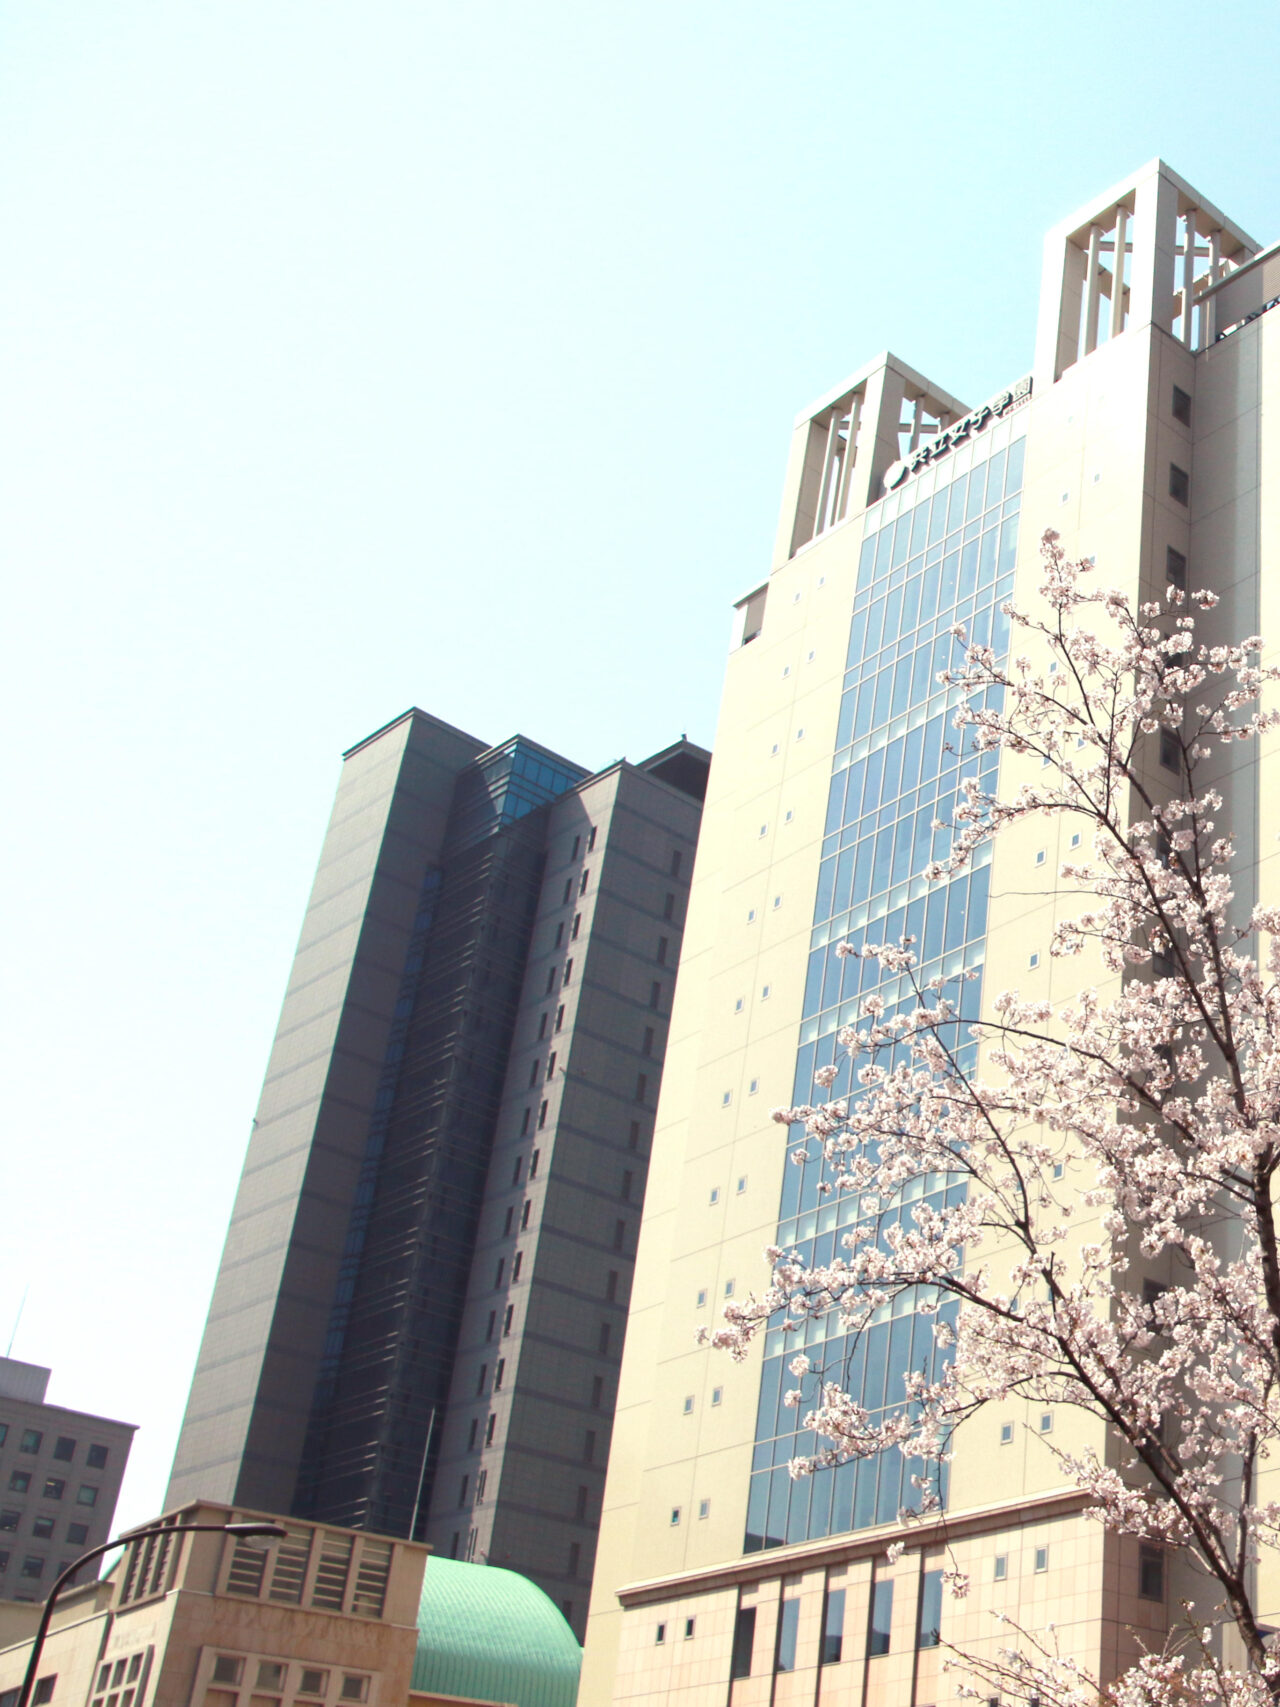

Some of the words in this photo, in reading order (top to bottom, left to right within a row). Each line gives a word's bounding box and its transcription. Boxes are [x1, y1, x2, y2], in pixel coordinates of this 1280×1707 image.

[910, 376, 1033, 473] 共立女子学園
